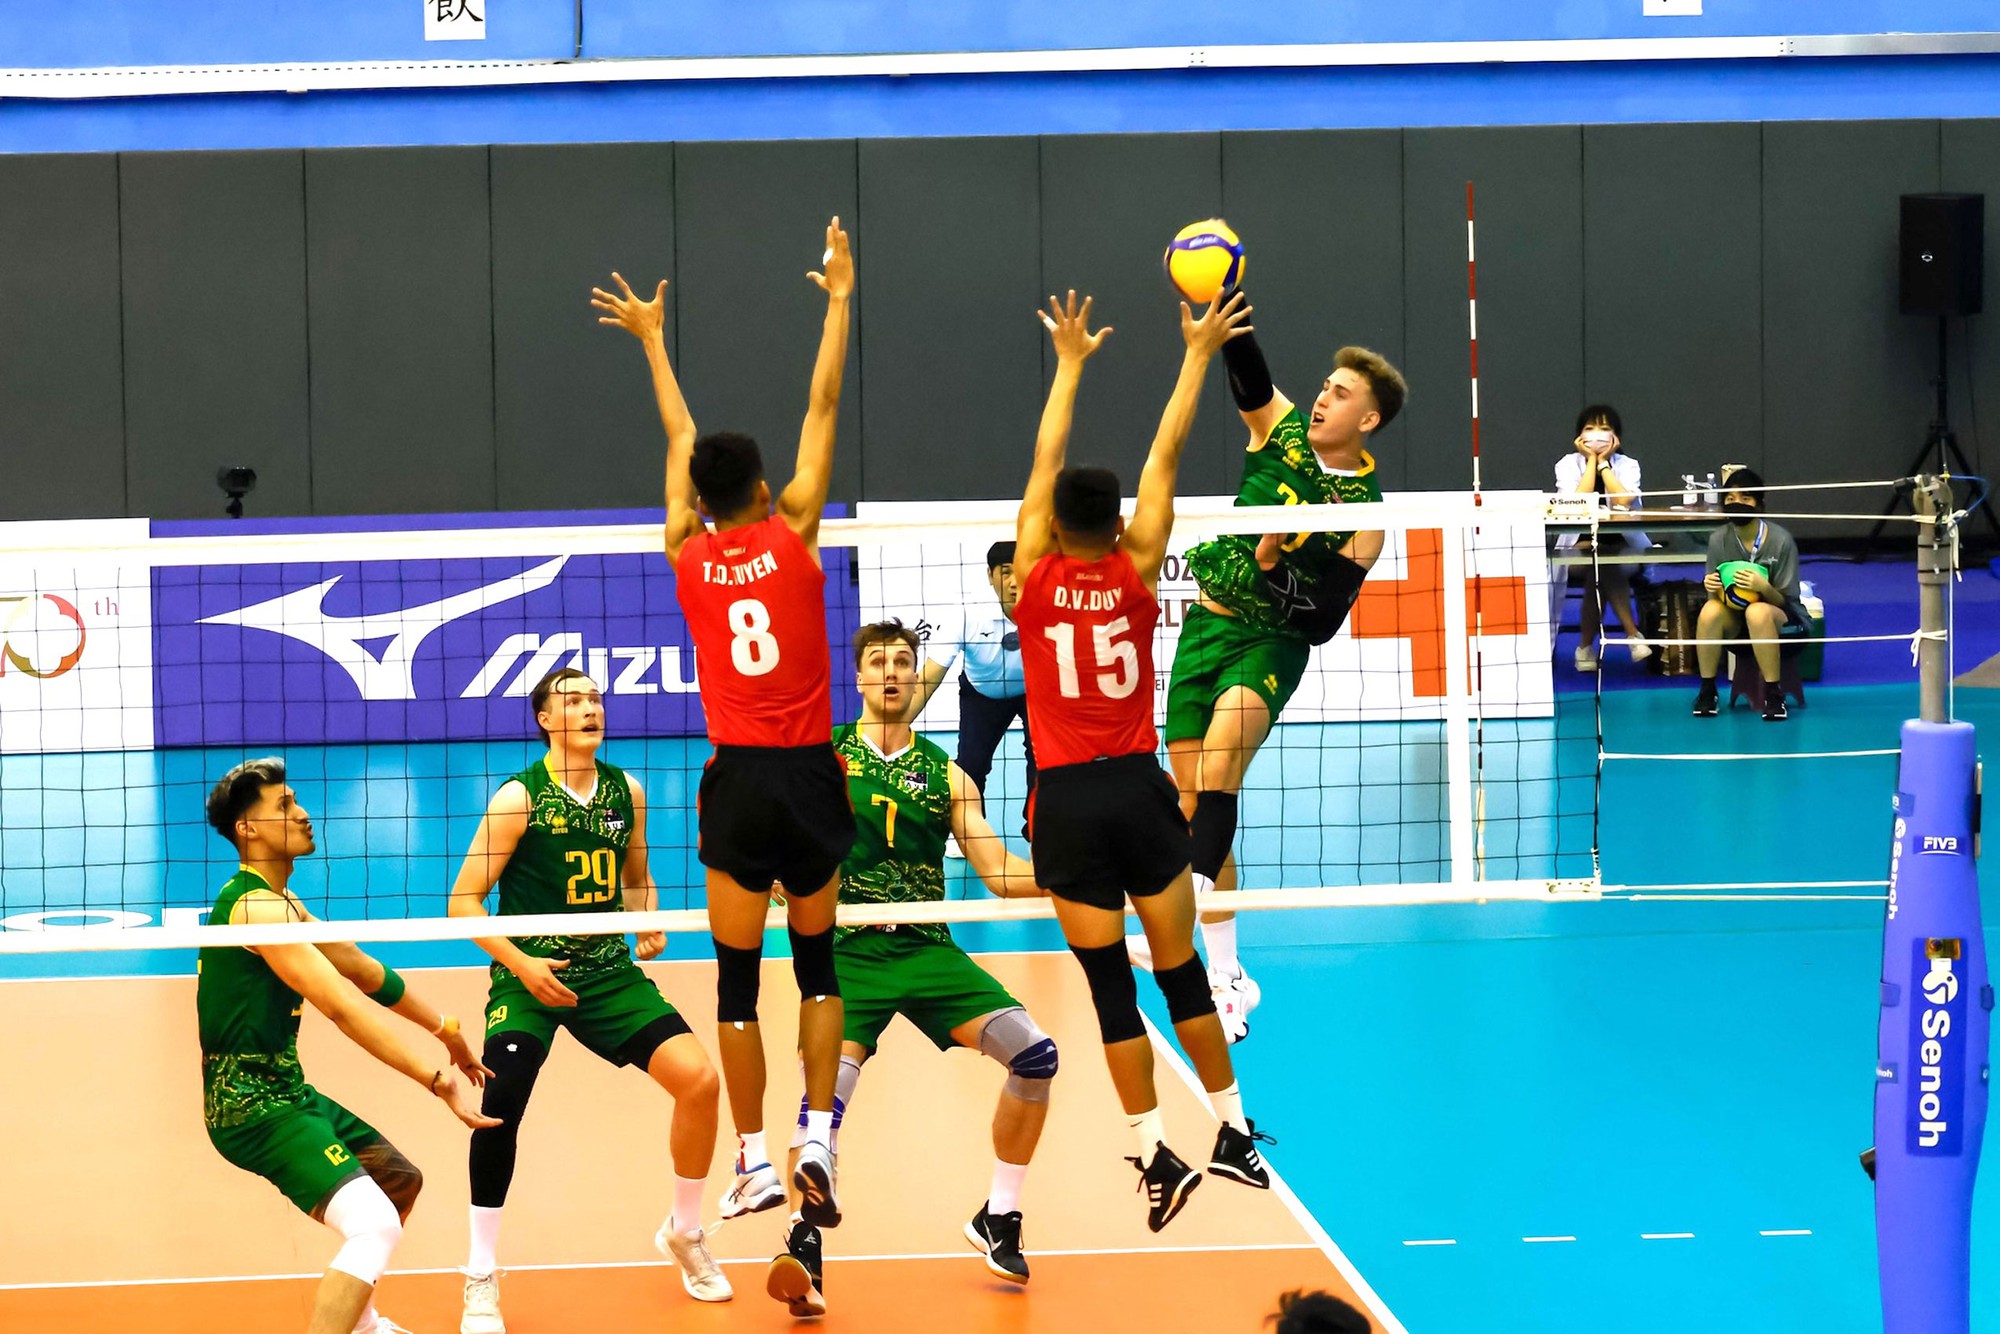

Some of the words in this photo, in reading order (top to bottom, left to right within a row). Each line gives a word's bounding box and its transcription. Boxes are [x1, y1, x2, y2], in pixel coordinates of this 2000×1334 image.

[94, 596, 120, 616] th
[1053, 585, 1122, 611] D.V.DUY
[727, 598, 780, 677] 8
[1044, 615, 1140, 699] 15
[871, 793, 898, 848] 7
[565, 848, 616, 905] 29
[1888, 840, 1904, 920] Senoh
[487, 1005, 508, 1030] 29
[1919, 1008, 1951, 1147] Senoh
[323, 1143, 351, 1167] 12
